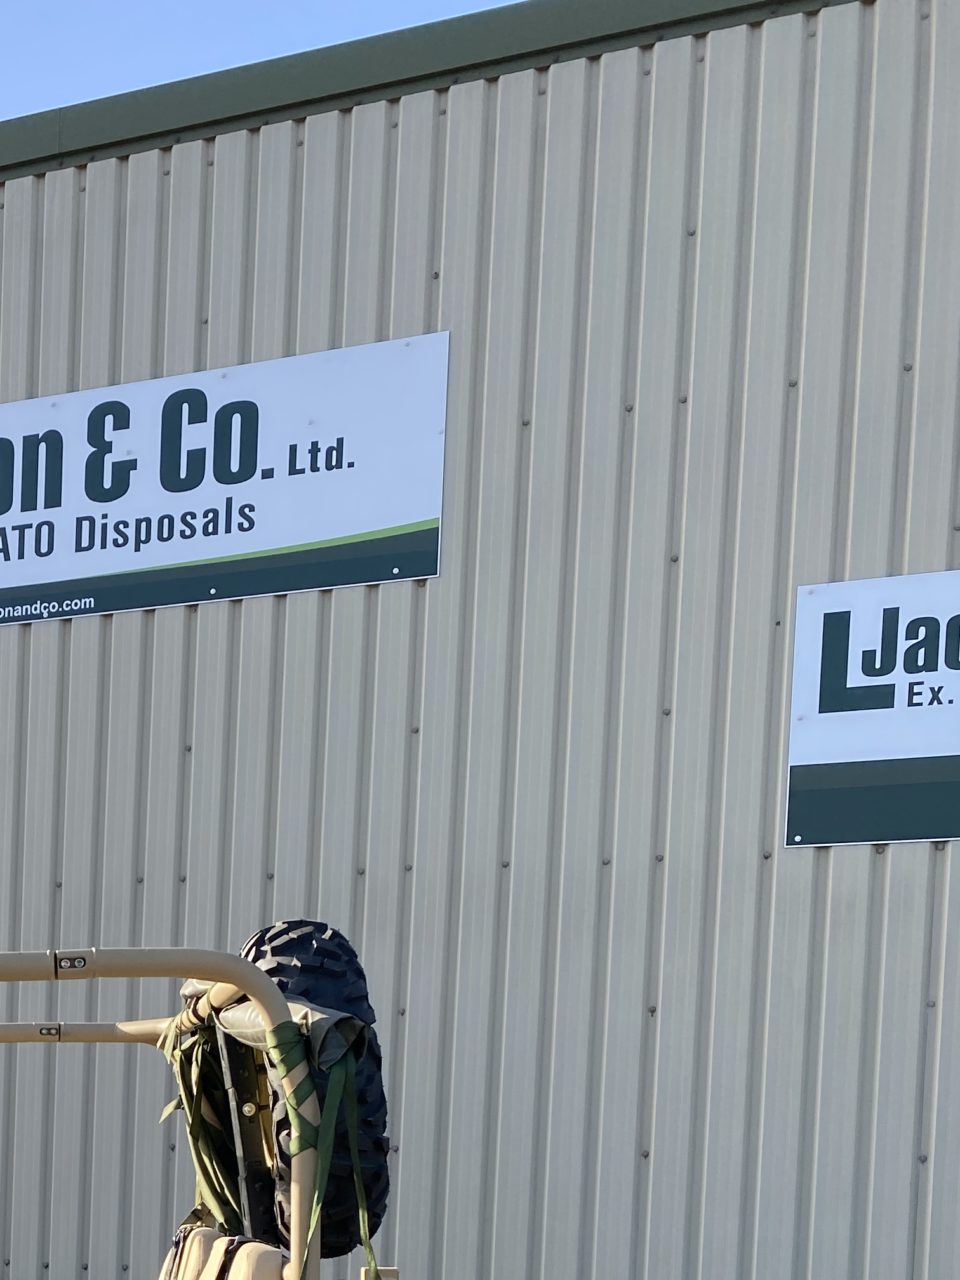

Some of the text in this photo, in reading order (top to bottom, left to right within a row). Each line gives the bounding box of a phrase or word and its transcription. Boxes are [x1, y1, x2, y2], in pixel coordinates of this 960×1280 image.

[84, 400, 138, 504] &
[159, 388, 275, 494] Co.
[287, 436, 355, 477] Ltd.
[74, 496, 256, 553] Disposals
[907, 680, 954, 708] Ex.
